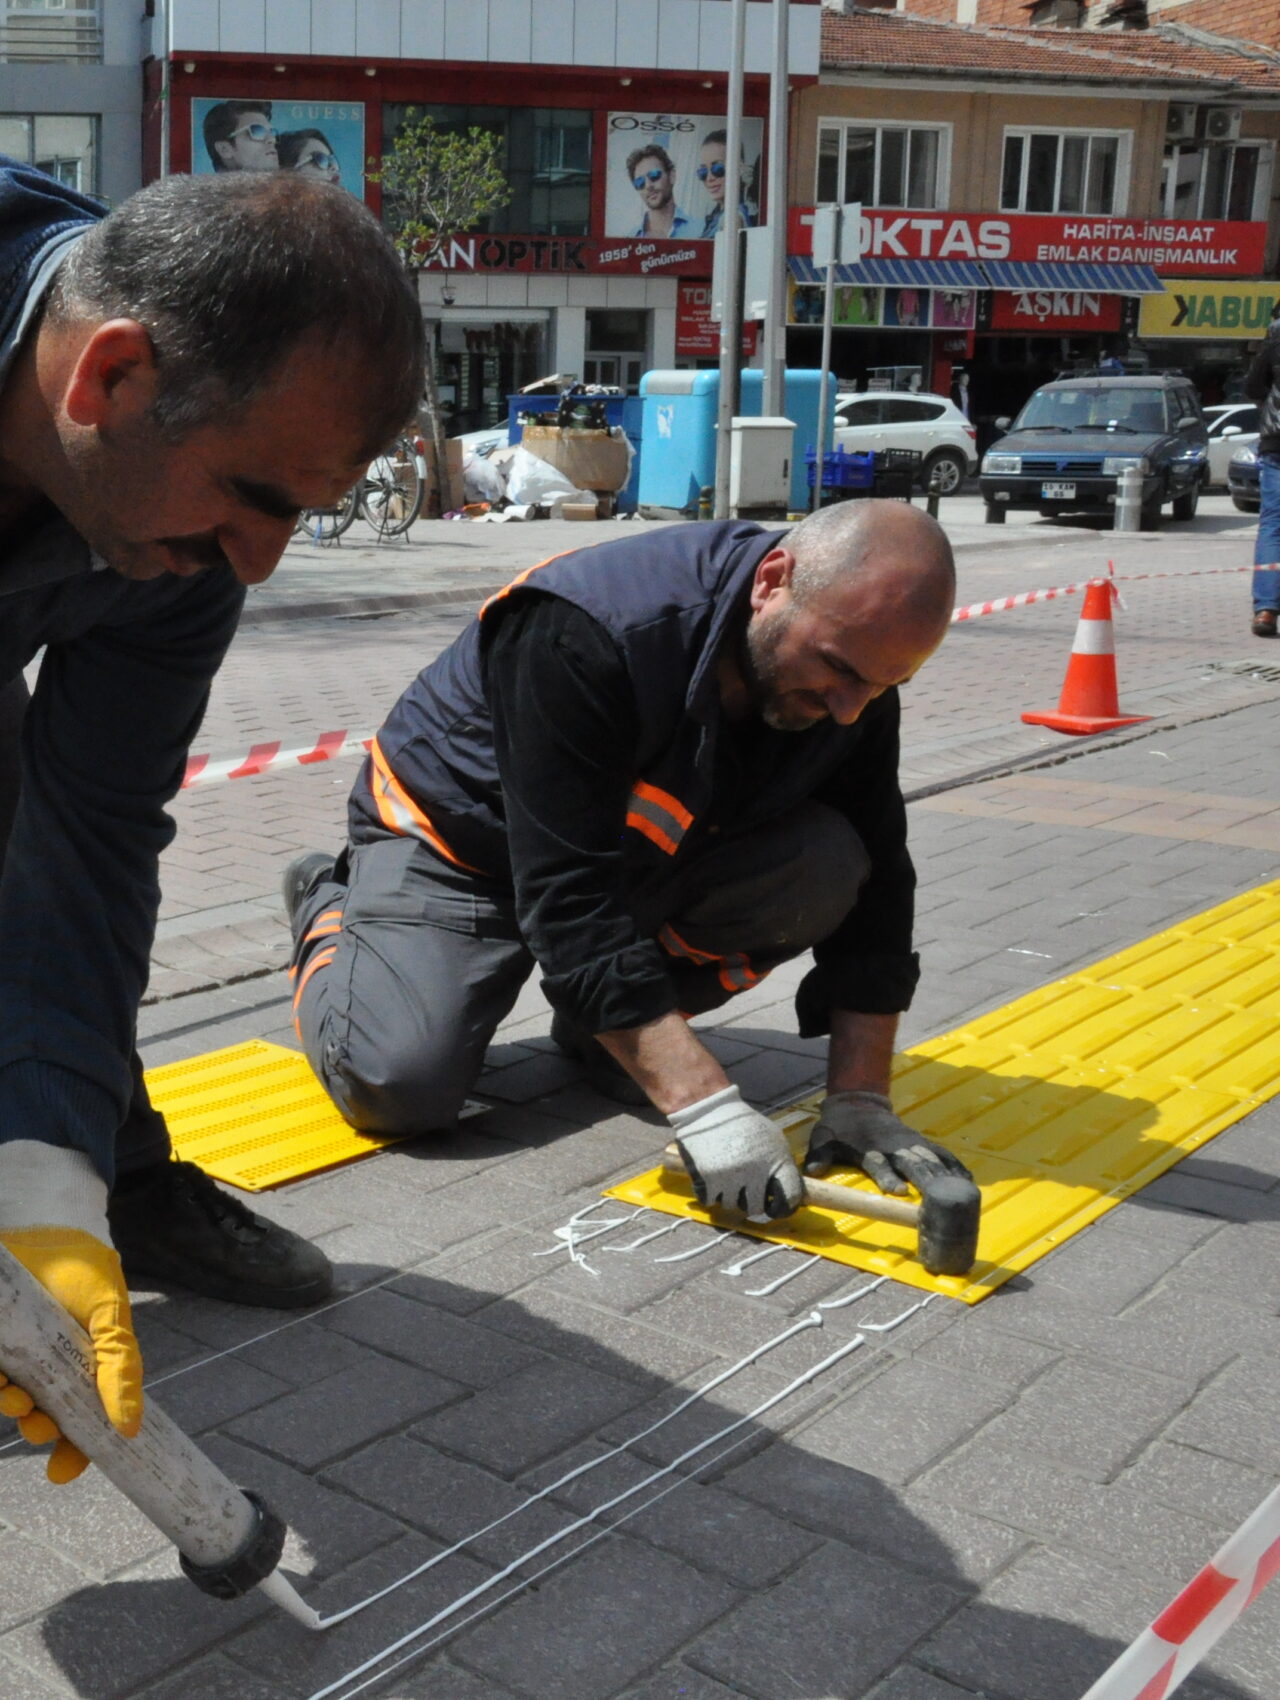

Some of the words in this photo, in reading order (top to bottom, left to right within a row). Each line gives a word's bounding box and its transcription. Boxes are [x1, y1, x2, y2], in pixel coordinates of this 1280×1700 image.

[291, 105, 361, 121] GUESS
[611, 115, 696, 132] Ossé
[640, 249, 697, 273] günümüze
[1036, 244, 1104, 262] EMLAK
[1107, 246, 1238, 265] DANIŞMANLIK
[682, 287, 711, 305] TO
[1013, 291, 1100, 322] AŞKIN
